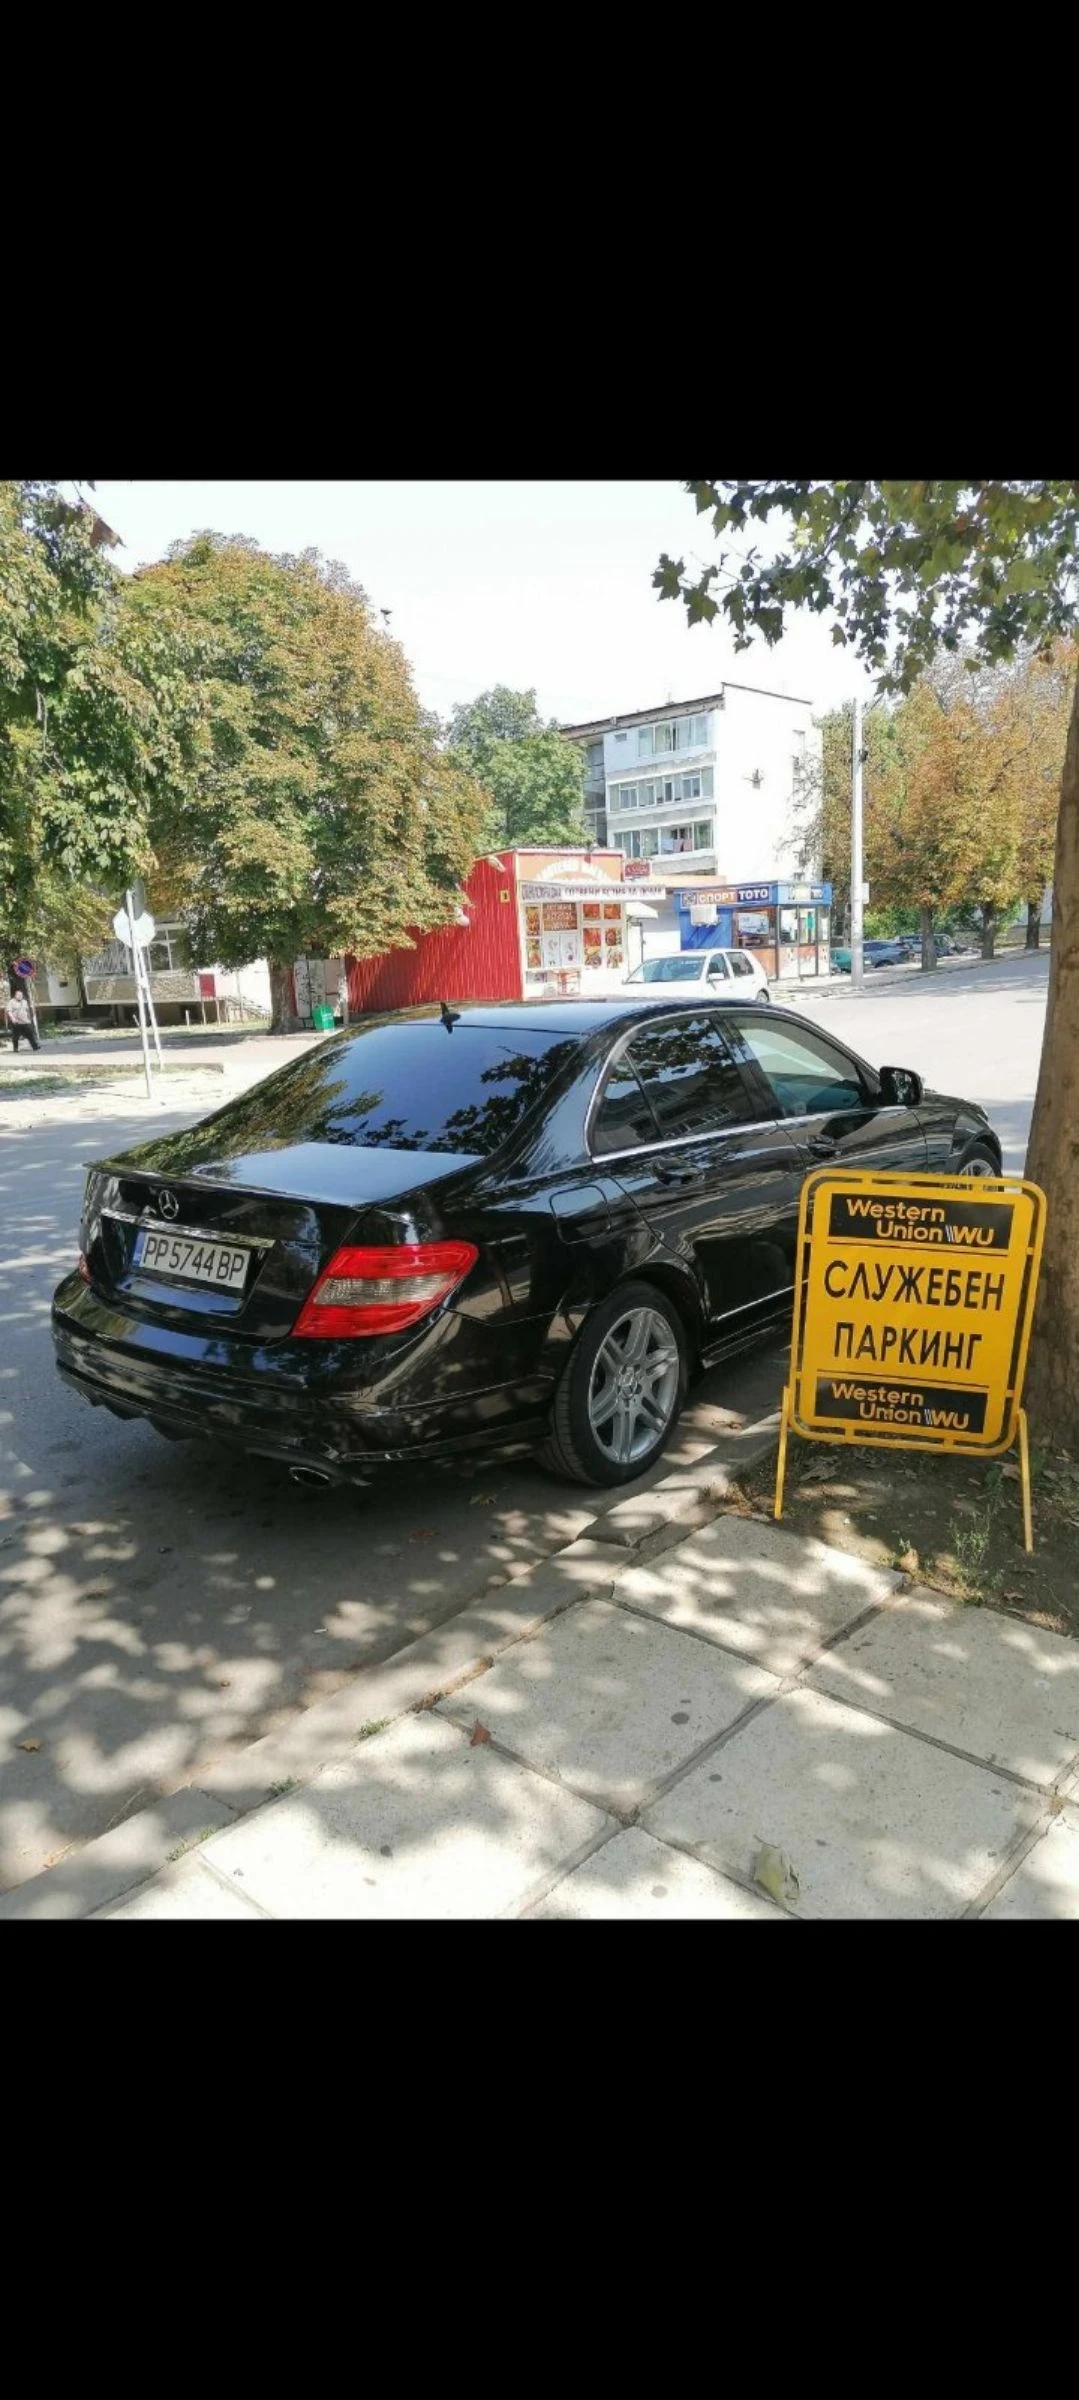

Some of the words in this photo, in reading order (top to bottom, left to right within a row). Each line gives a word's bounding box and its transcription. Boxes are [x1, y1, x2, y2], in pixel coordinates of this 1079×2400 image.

[699, 891, 736, 905] СПОРТ
[738, 887, 769, 901] ТОТО
[846, 1199, 945, 1222] Western
[876, 1220, 943, 1242] Union
[824, 1260, 1006, 1311] СЛУЖЕБЕН
[833, 1321, 983, 1370] ПАРКИНГ
[831, 1383, 924, 1406] Western
[859, 1403, 921, 1424] Union
